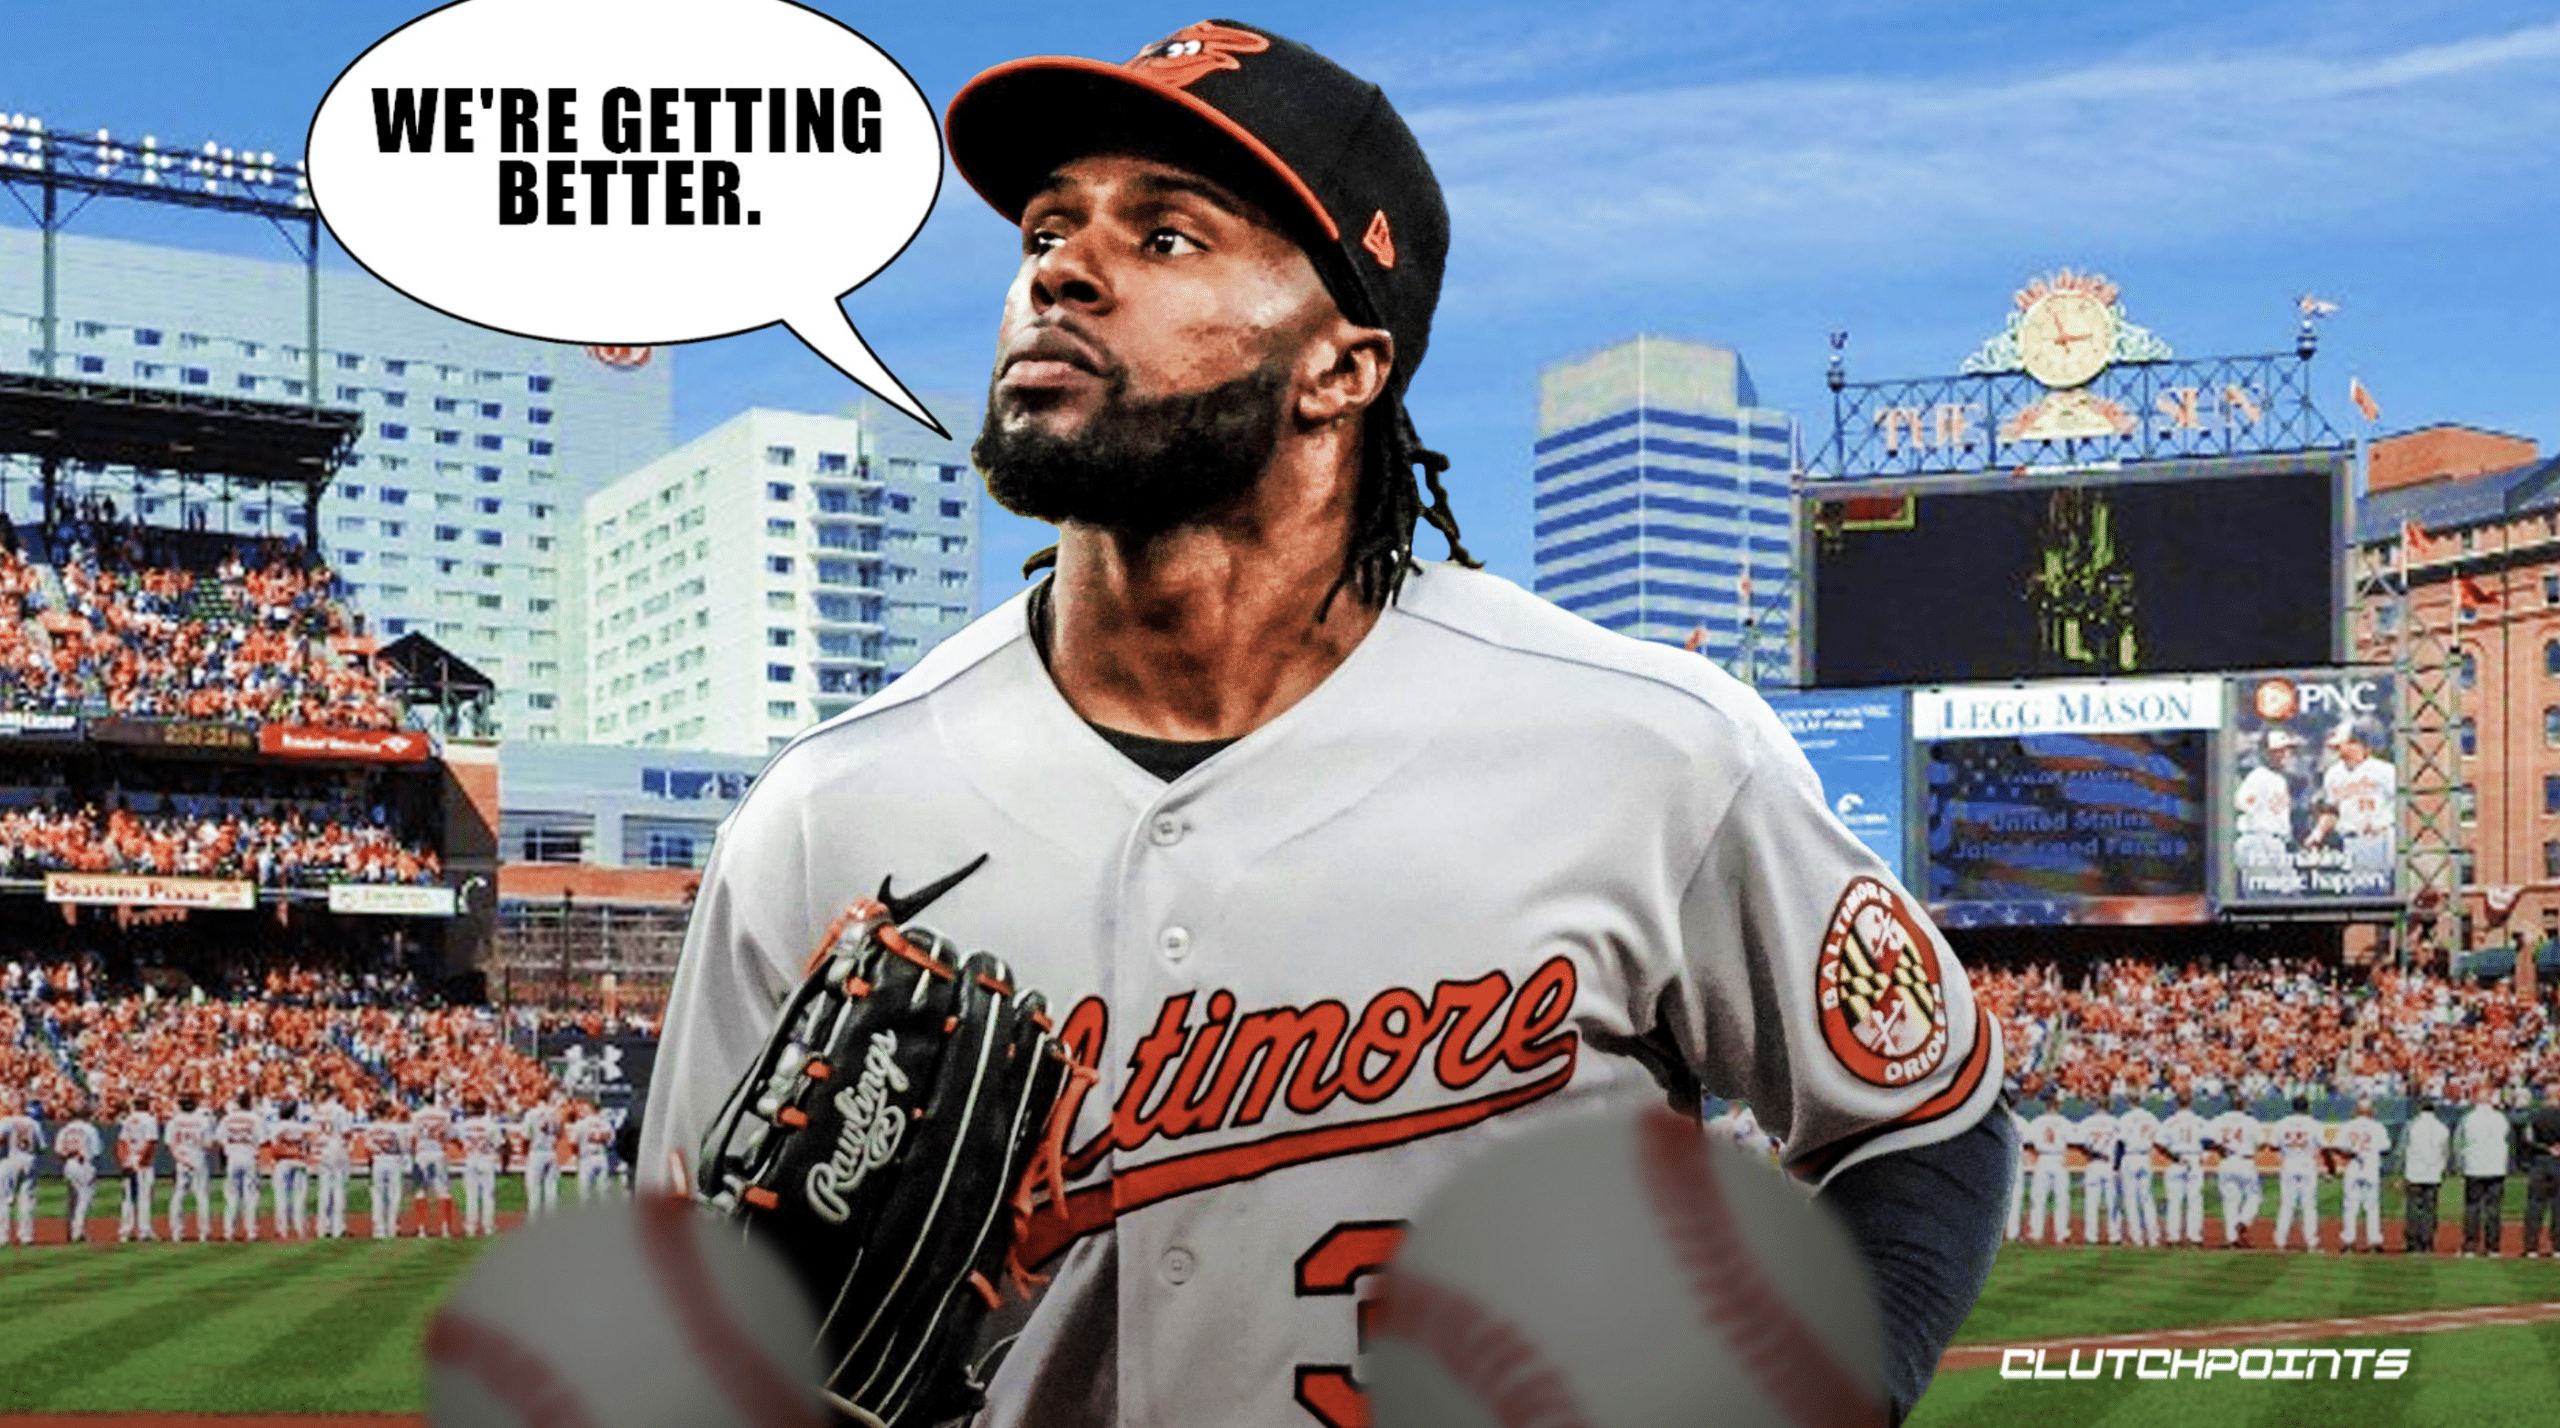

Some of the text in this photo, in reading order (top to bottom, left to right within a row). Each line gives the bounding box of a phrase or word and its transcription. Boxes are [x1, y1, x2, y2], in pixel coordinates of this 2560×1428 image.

[1943, 692, 2193, 731] LEGG MASON
[2295, 682, 2378, 714] PNC
[1821, 881, 1893, 1011] BALTIMORE
[806, 1028, 910, 1223] Rawlings
